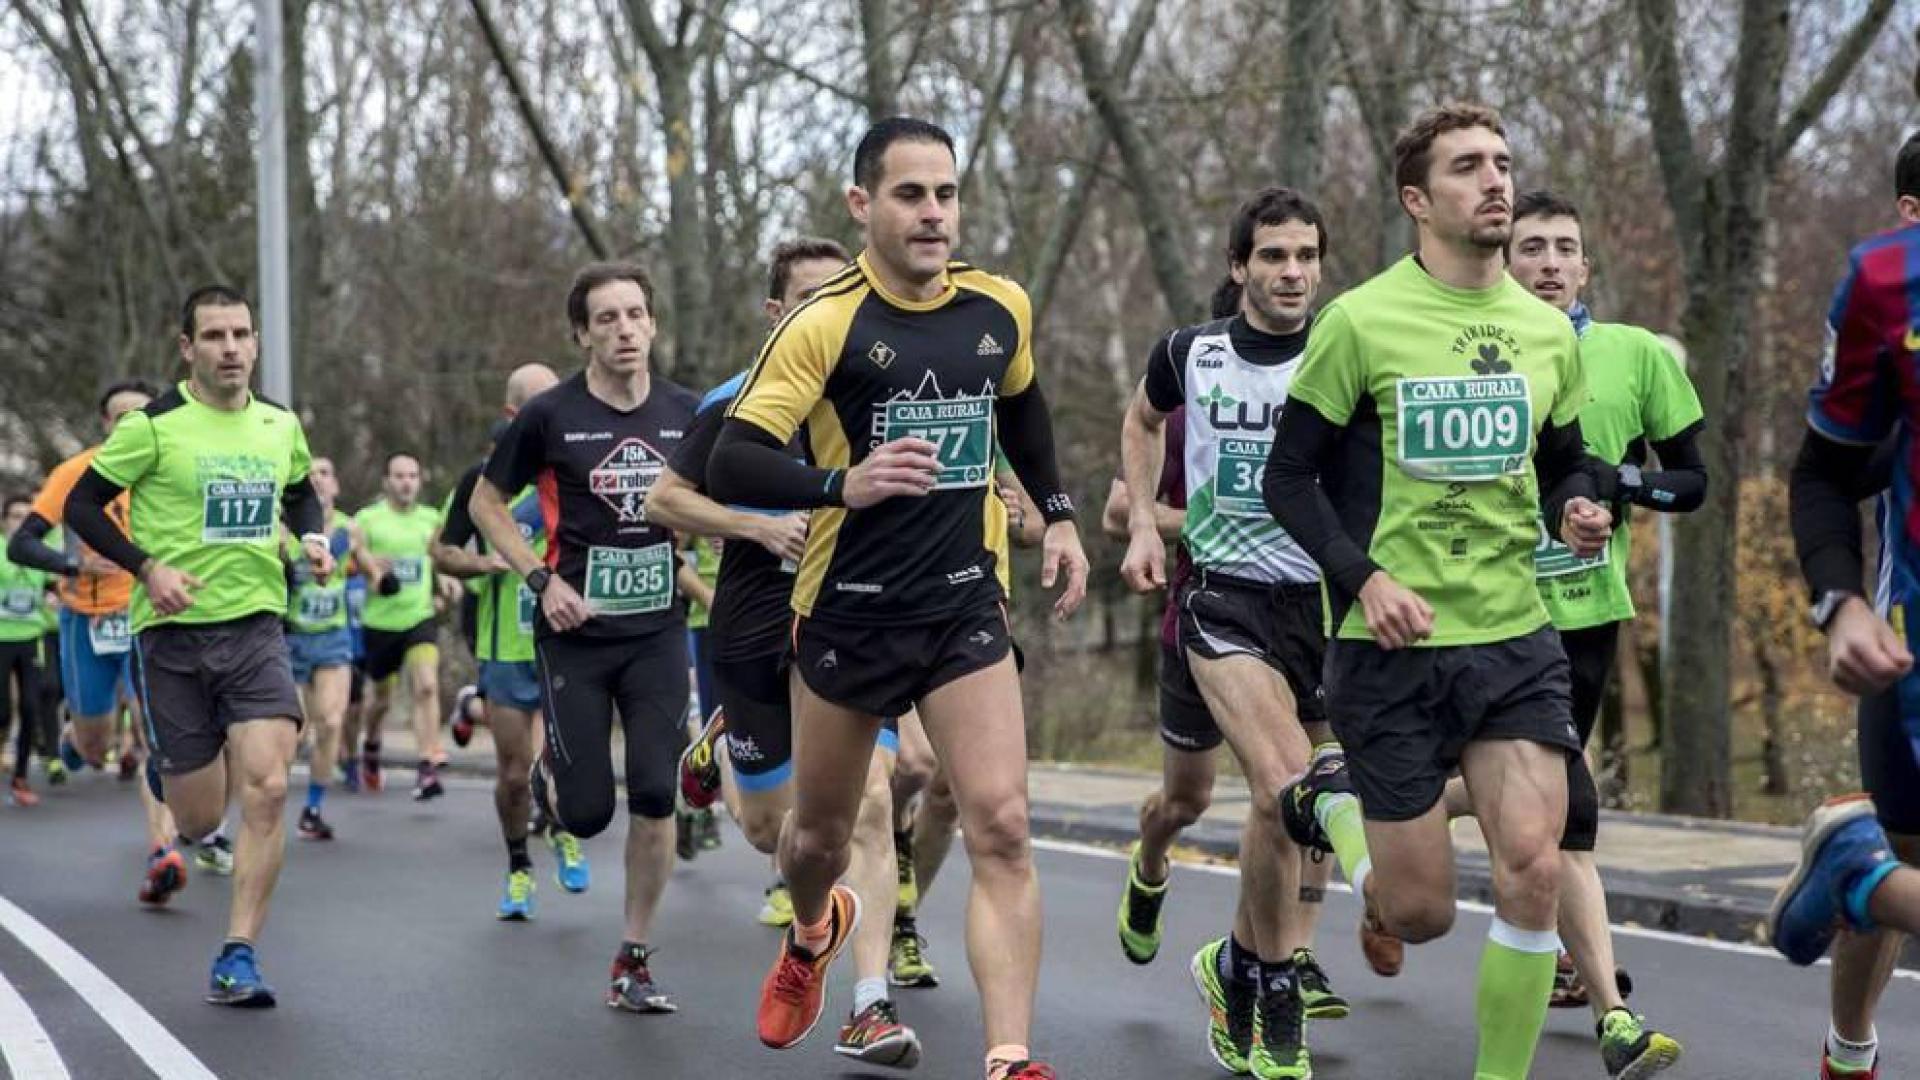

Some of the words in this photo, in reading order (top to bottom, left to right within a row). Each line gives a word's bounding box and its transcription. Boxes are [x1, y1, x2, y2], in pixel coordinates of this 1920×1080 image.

[1412, 382, 1460, 400] CAJA
[1465, 380, 1521, 398] RURAL
[896, 405, 933, 420] CAJA
[937, 402, 984, 419] RURAL
[1416, 404, 1518, 451] 1009
[218, 499, 261, 524] 117
[598, 565, 665, 596] 1035
